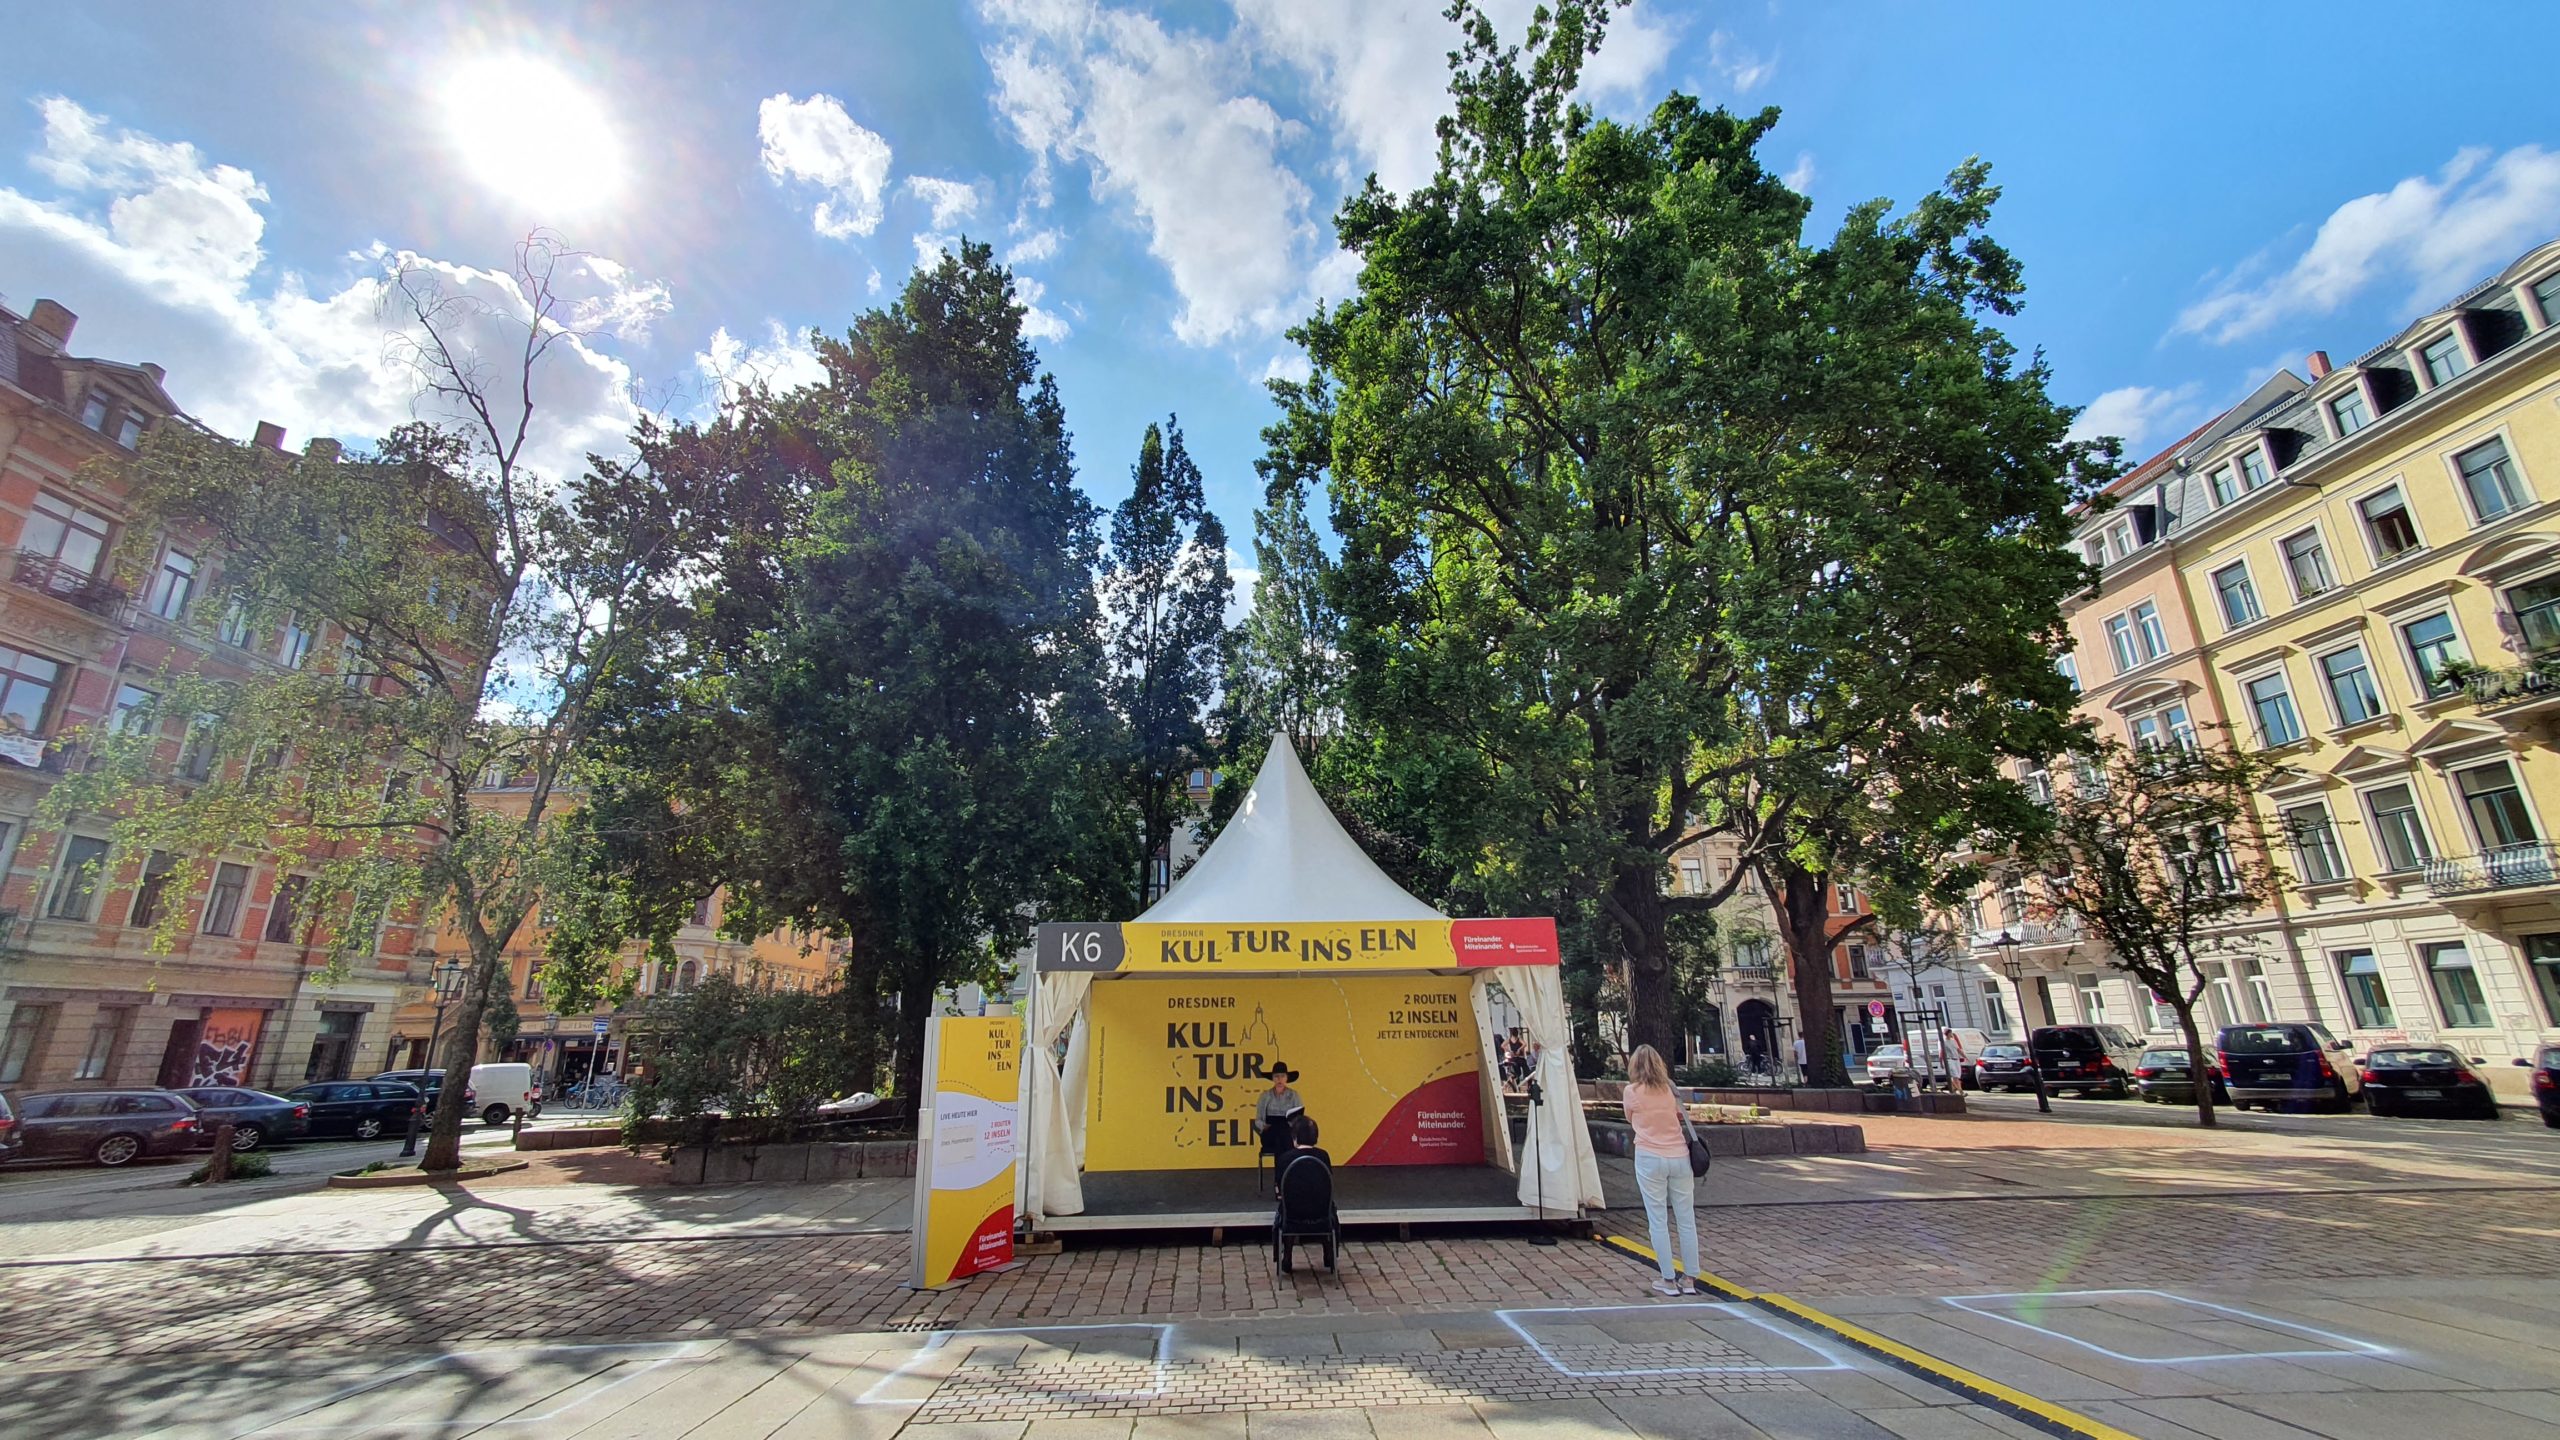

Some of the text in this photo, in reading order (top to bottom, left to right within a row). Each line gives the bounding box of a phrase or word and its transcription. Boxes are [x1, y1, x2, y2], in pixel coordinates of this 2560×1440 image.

[1464, 935, 1503, 943] Füreinander.
[1061, 932, 1102, 962] K6
[1161, 929, 1416, 963] KUL TUR INS ELN
[1464, 942, 1504, 950] Miteinander.
[1168, 997, 1236, 1008] DRESDNER
[1404, 994, 1457, 1005] 2 ROUTEN
[1389, 1010, 1458, 1024] 12 INSELN
[989, 1029, 1004, 1039] KUL
[1167, 1022, 1236, 1048] KUL
[1377, 1029, 1459, 1039] JETZT ENTDECKEN!
[995, 1040, 1011, 1049] TUR
[988, 1051, 1002, 1060] INS
[997, 1061, 1012, 1071] ELN
[1193, 1053, 1266, 1080] TUR
[1165, 1085, 1224, 1113] INS
[1417, 1110, 1466, 1119] Füreinander.
[1418, 1120, 1466, 1129] Miteinander.
[991, 1128, 1011, 1139] INSELN
